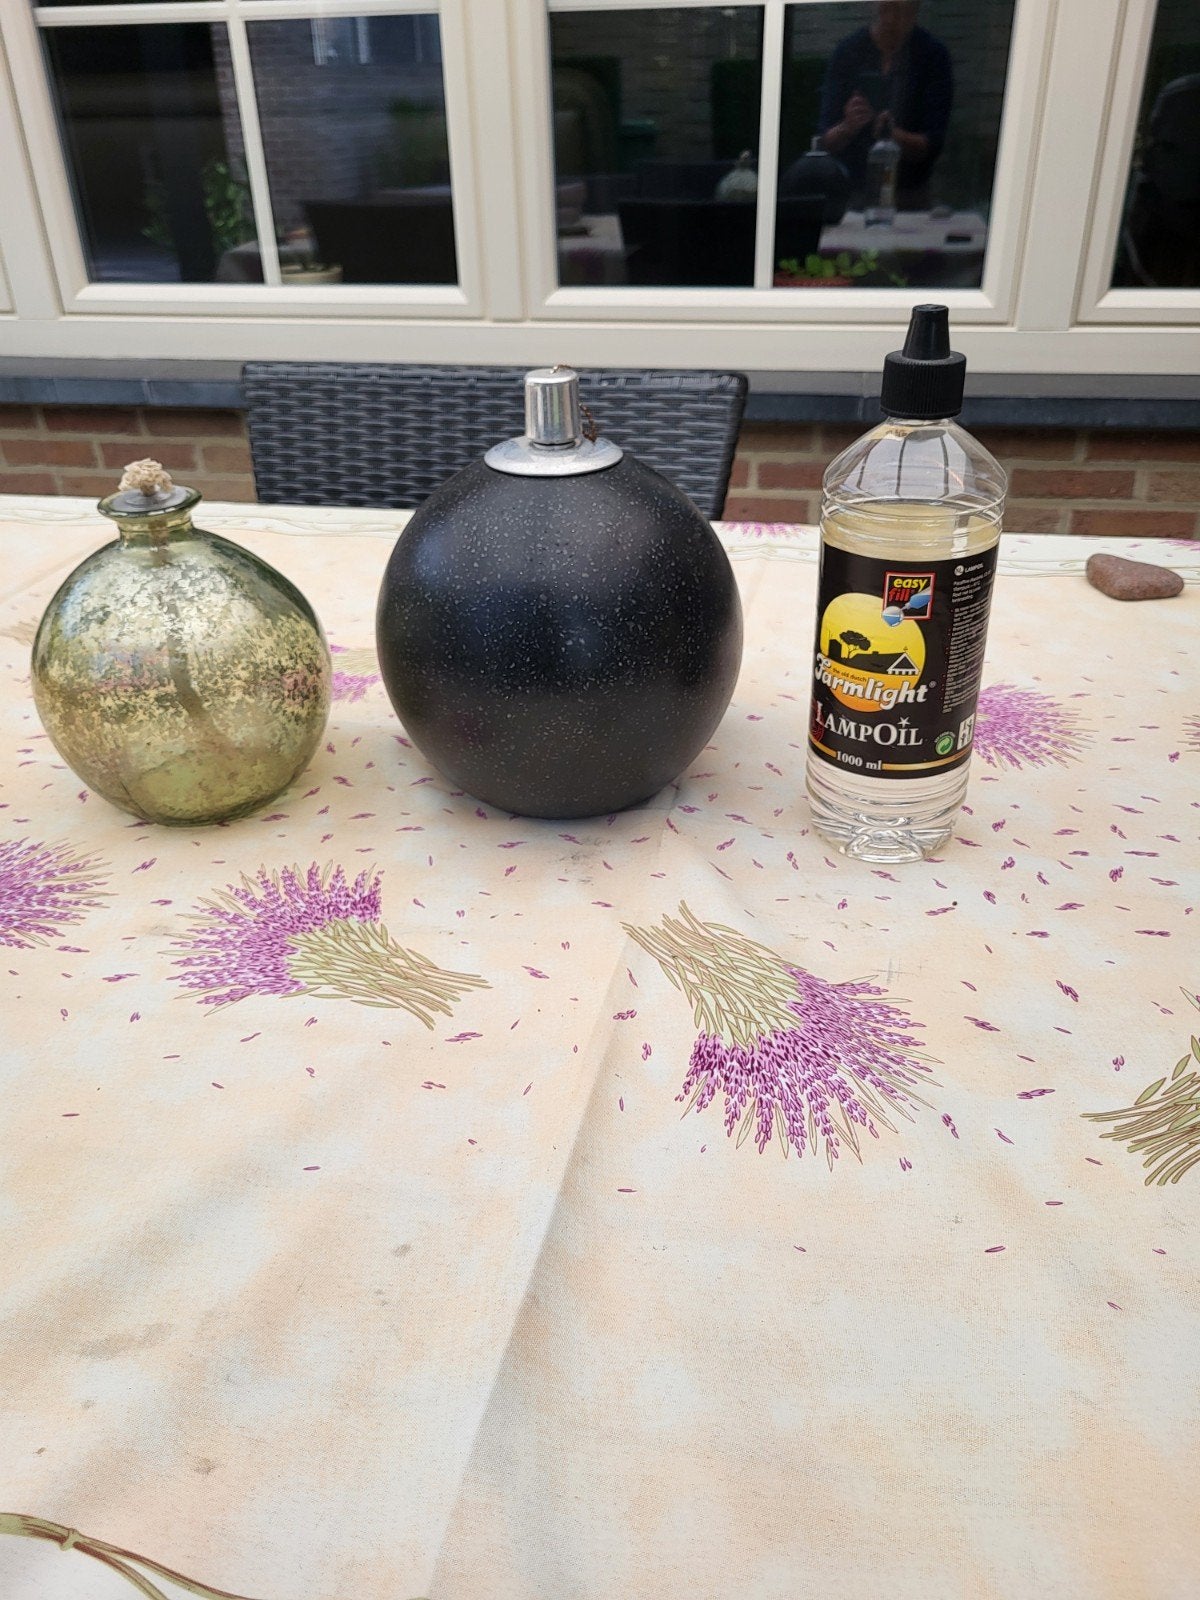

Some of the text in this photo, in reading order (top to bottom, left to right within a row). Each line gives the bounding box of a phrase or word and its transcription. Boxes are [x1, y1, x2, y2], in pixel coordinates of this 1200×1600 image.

[893, 578, 928, 592] easy
[888, 588, 911, 602] fill
[815, 652, 929, 710] Farmlight
[836, 750, 882, 771] 1000 ml
